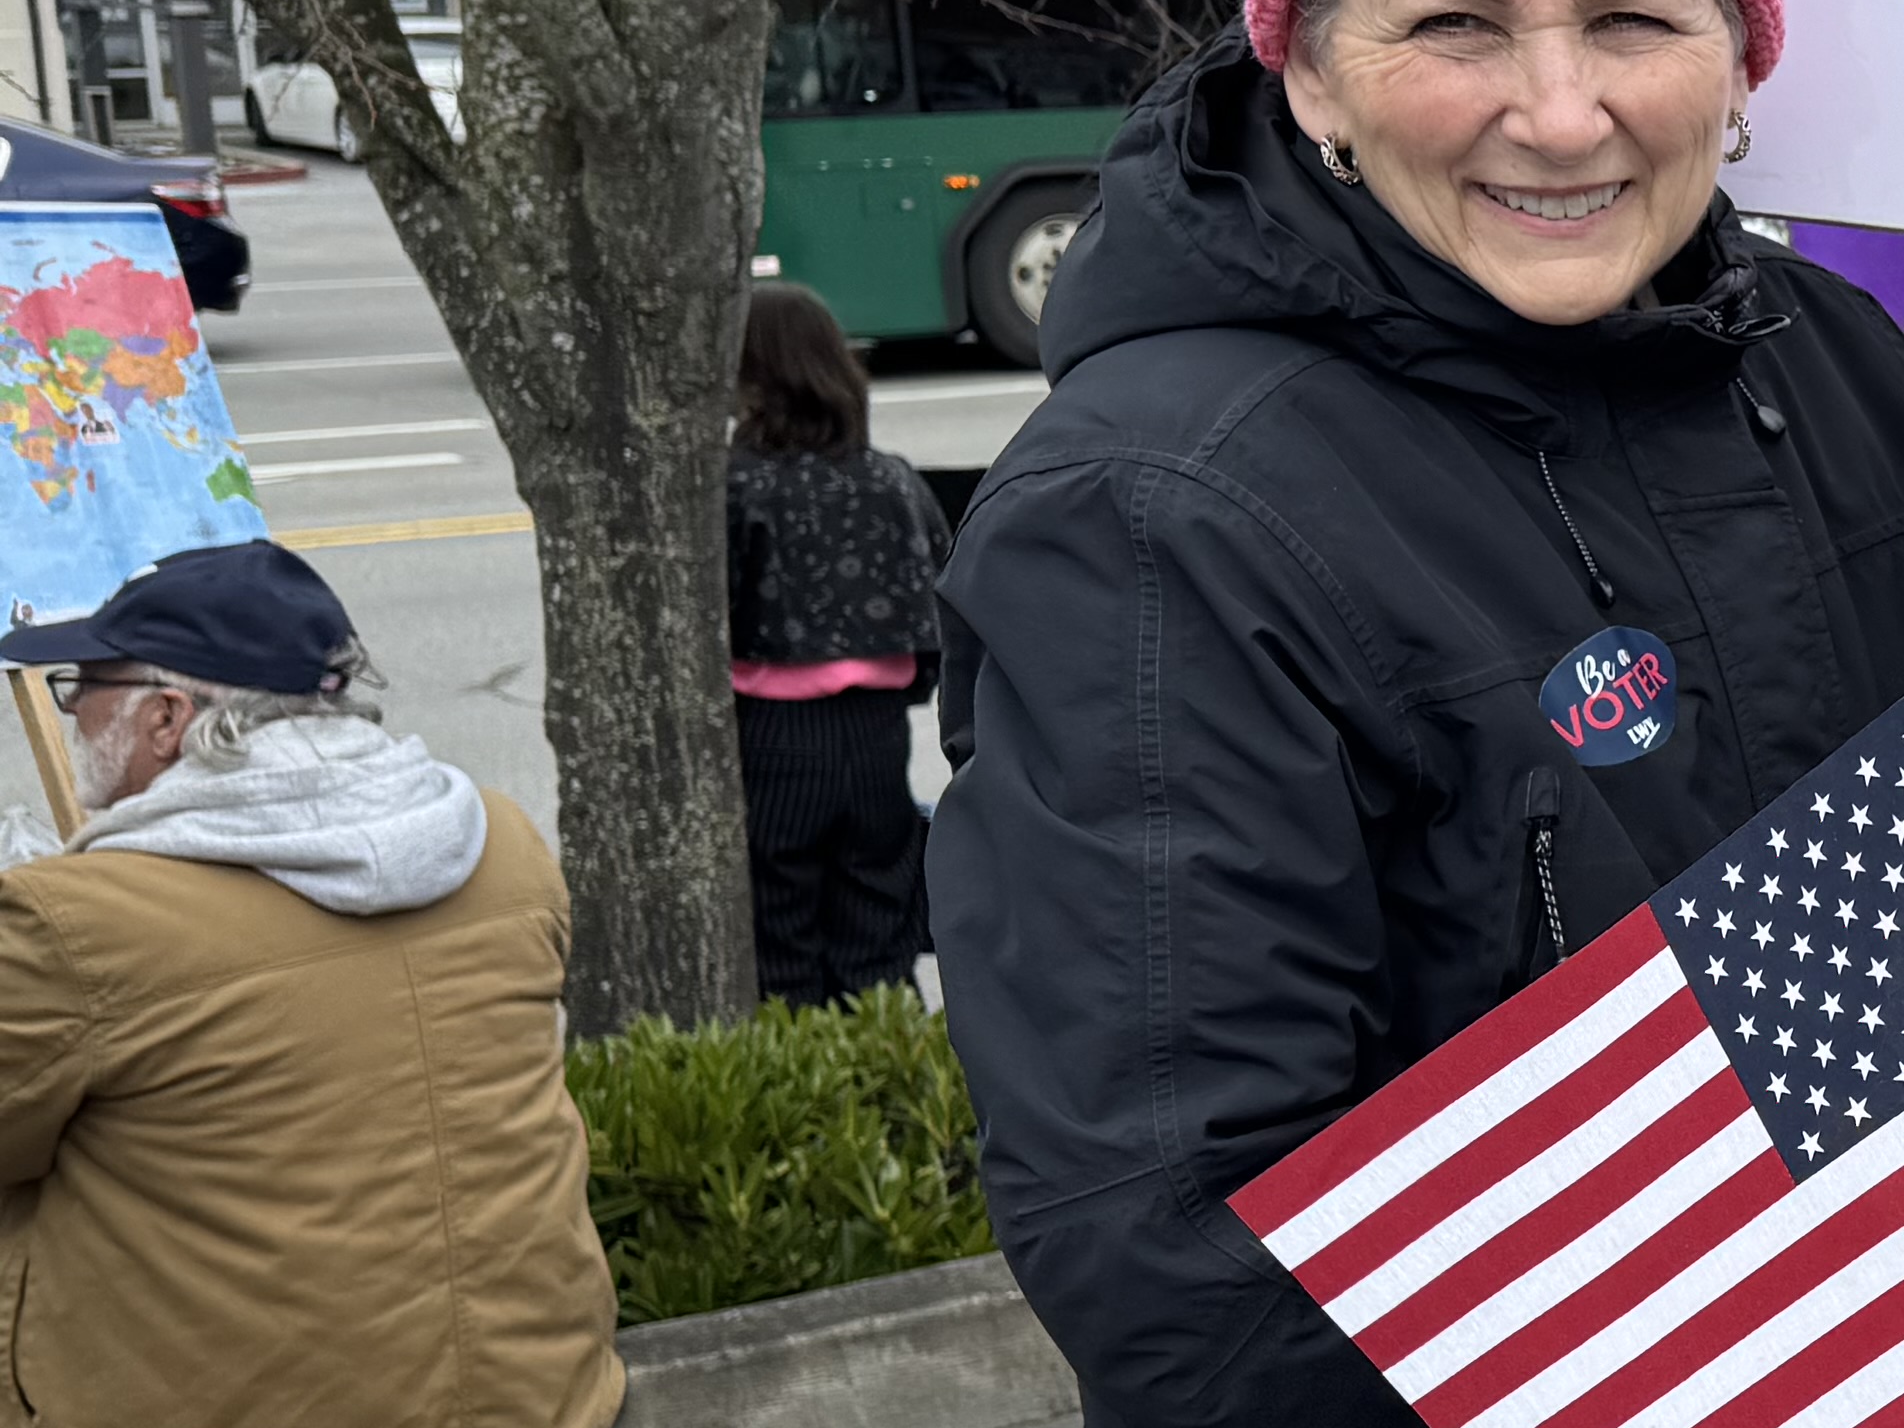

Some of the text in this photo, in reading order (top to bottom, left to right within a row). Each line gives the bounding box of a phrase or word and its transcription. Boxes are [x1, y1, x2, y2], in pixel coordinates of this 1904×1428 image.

[1550, 652, 1669, 748] VOTER
[1575, 647, 1632, 699] Be a
